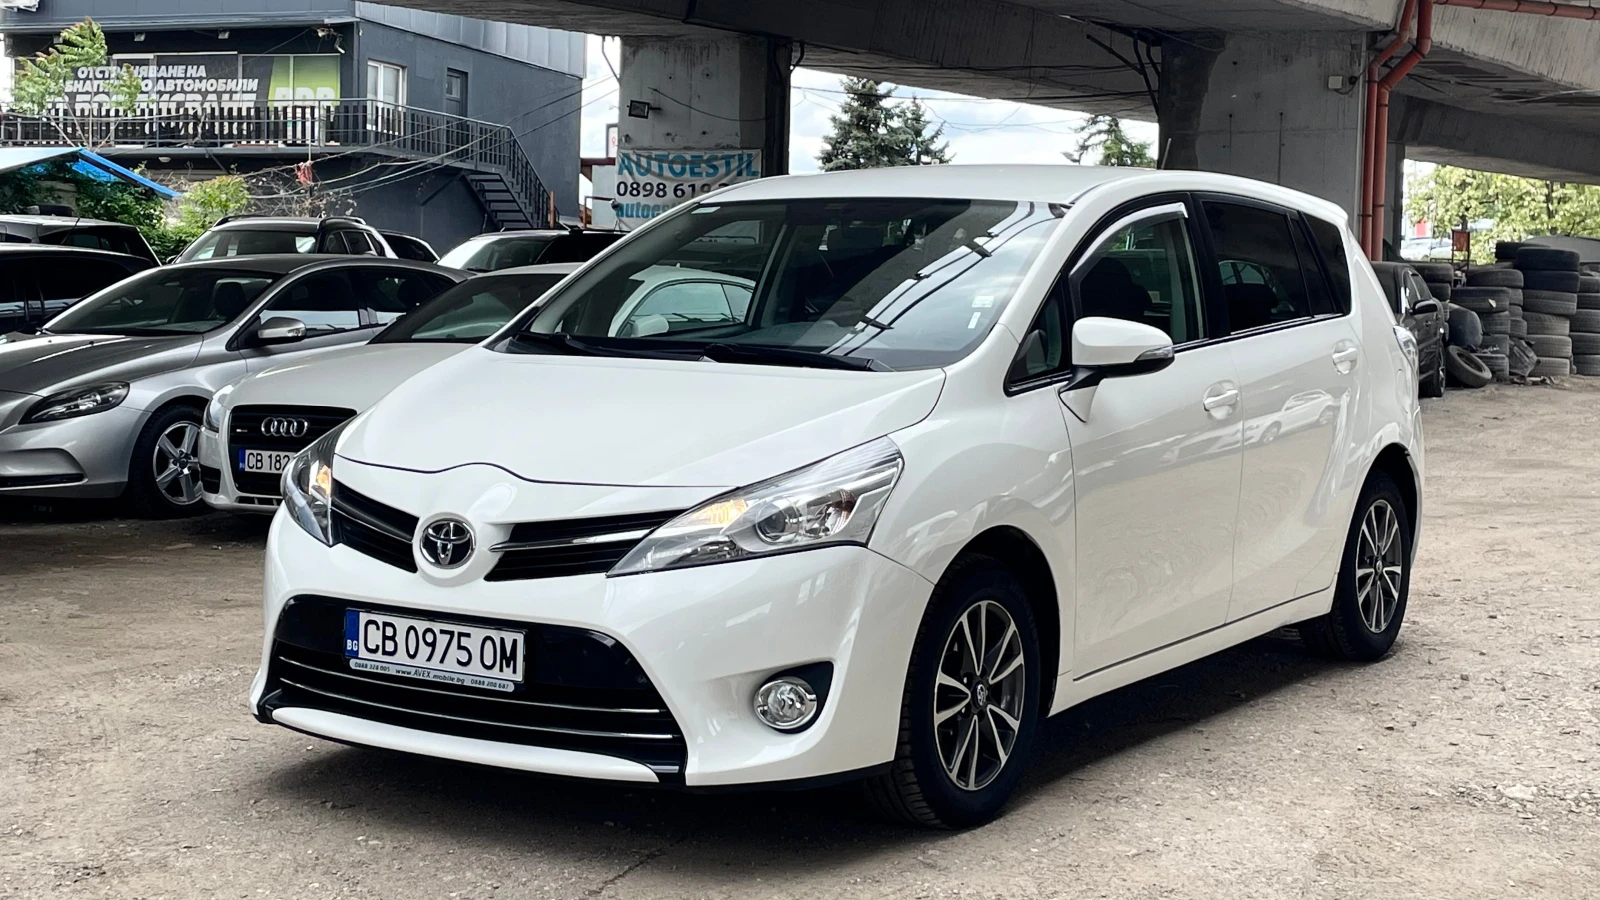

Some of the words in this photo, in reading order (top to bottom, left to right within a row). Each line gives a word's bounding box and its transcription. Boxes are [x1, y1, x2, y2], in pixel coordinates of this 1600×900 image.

[186, 65, 207, 78] НА
[154, 79, 259, 92] АВТОМОБИЛИ
[618, 152, 759, 178] AUTOESTIL
[616, 181, 667, 198] 0898
[247, 452, 263, 470] CB
[268, 453, 290, 471] 182
[346, 639, 358, 651] BG
[363, 619, 398, 656] CB
[405, 625, 472, 667] 0975
[480, 636, 518, 674] OM
